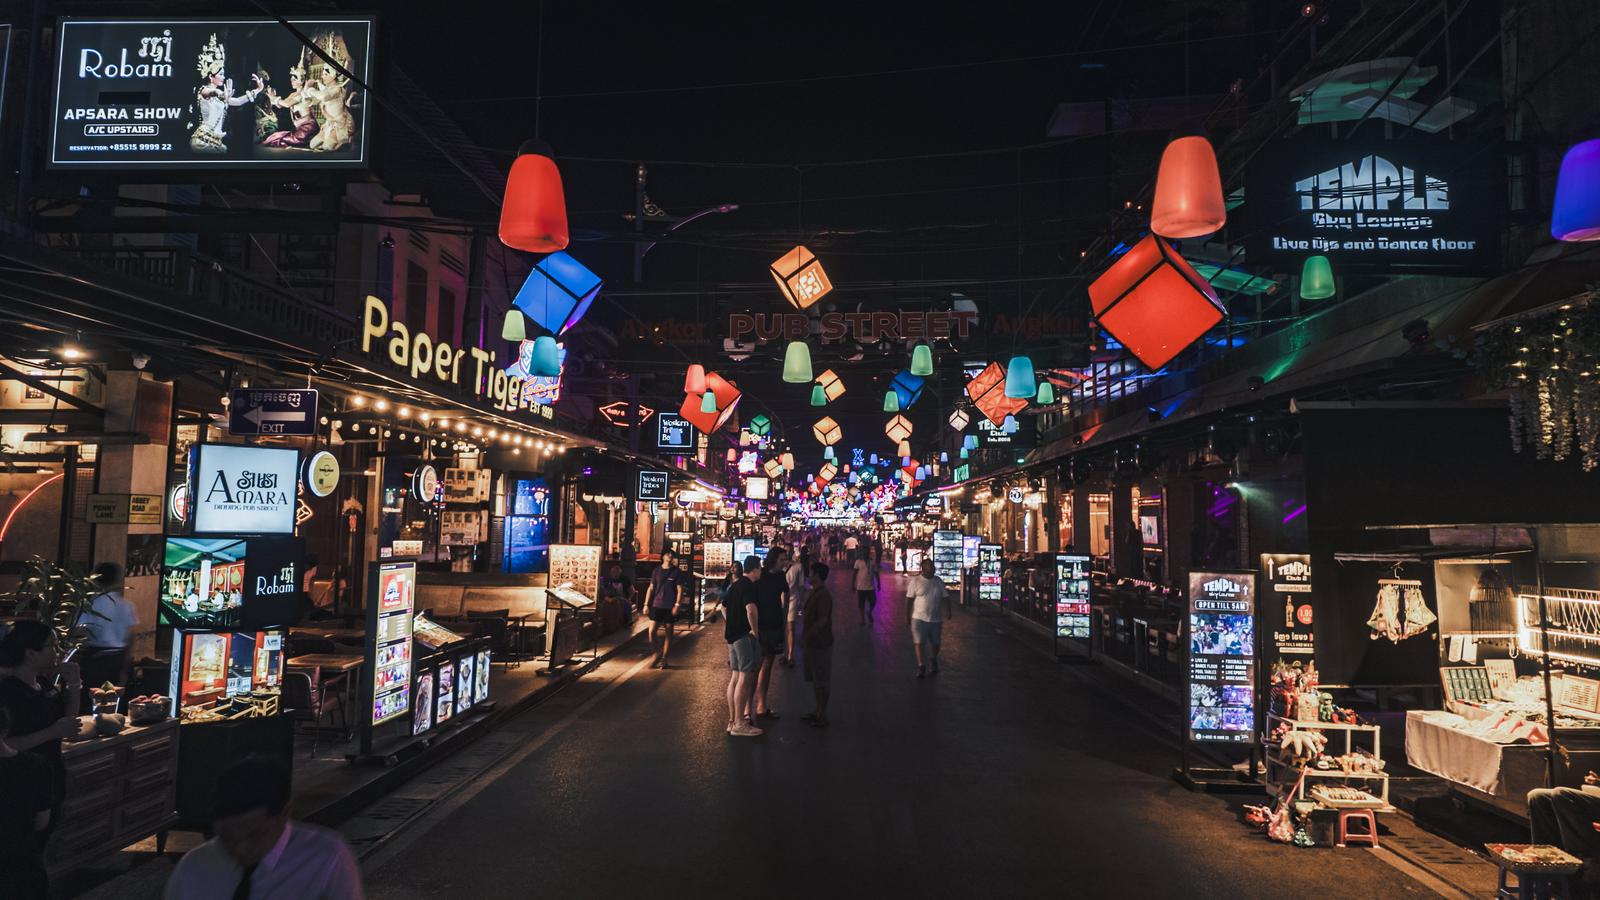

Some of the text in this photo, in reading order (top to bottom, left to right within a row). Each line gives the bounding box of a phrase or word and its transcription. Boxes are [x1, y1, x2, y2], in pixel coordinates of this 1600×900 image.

[79, 48, 171, 77] Robam
[64, 107, 181, 120] APSARA SHOW
[88, 126, 105, 134] A/C
[1295, 154, 1450, 210] TEMPLE
[1312, 212, 1433, 231] Sky Lounge
[1273, 237, 1309, 250] Live
[1343, 237, 1375, 250] and
[1377, 237, 1429, 250] Dance
[1431, 237, 1476, 251] Floor
[728, 311, 977, 341] PUB STREET
[362, 295, 465, 385] Paper
[262, 423, 285, 433] EXIT
[662, 419, 689, 427] Western
[204, 470, 288, 505] AMARA
[1277, 561, 1311, 576] TEMPL
[256, 575, 294, 596] Robam
[1203, 578, 1241, 593] TEMPLE
